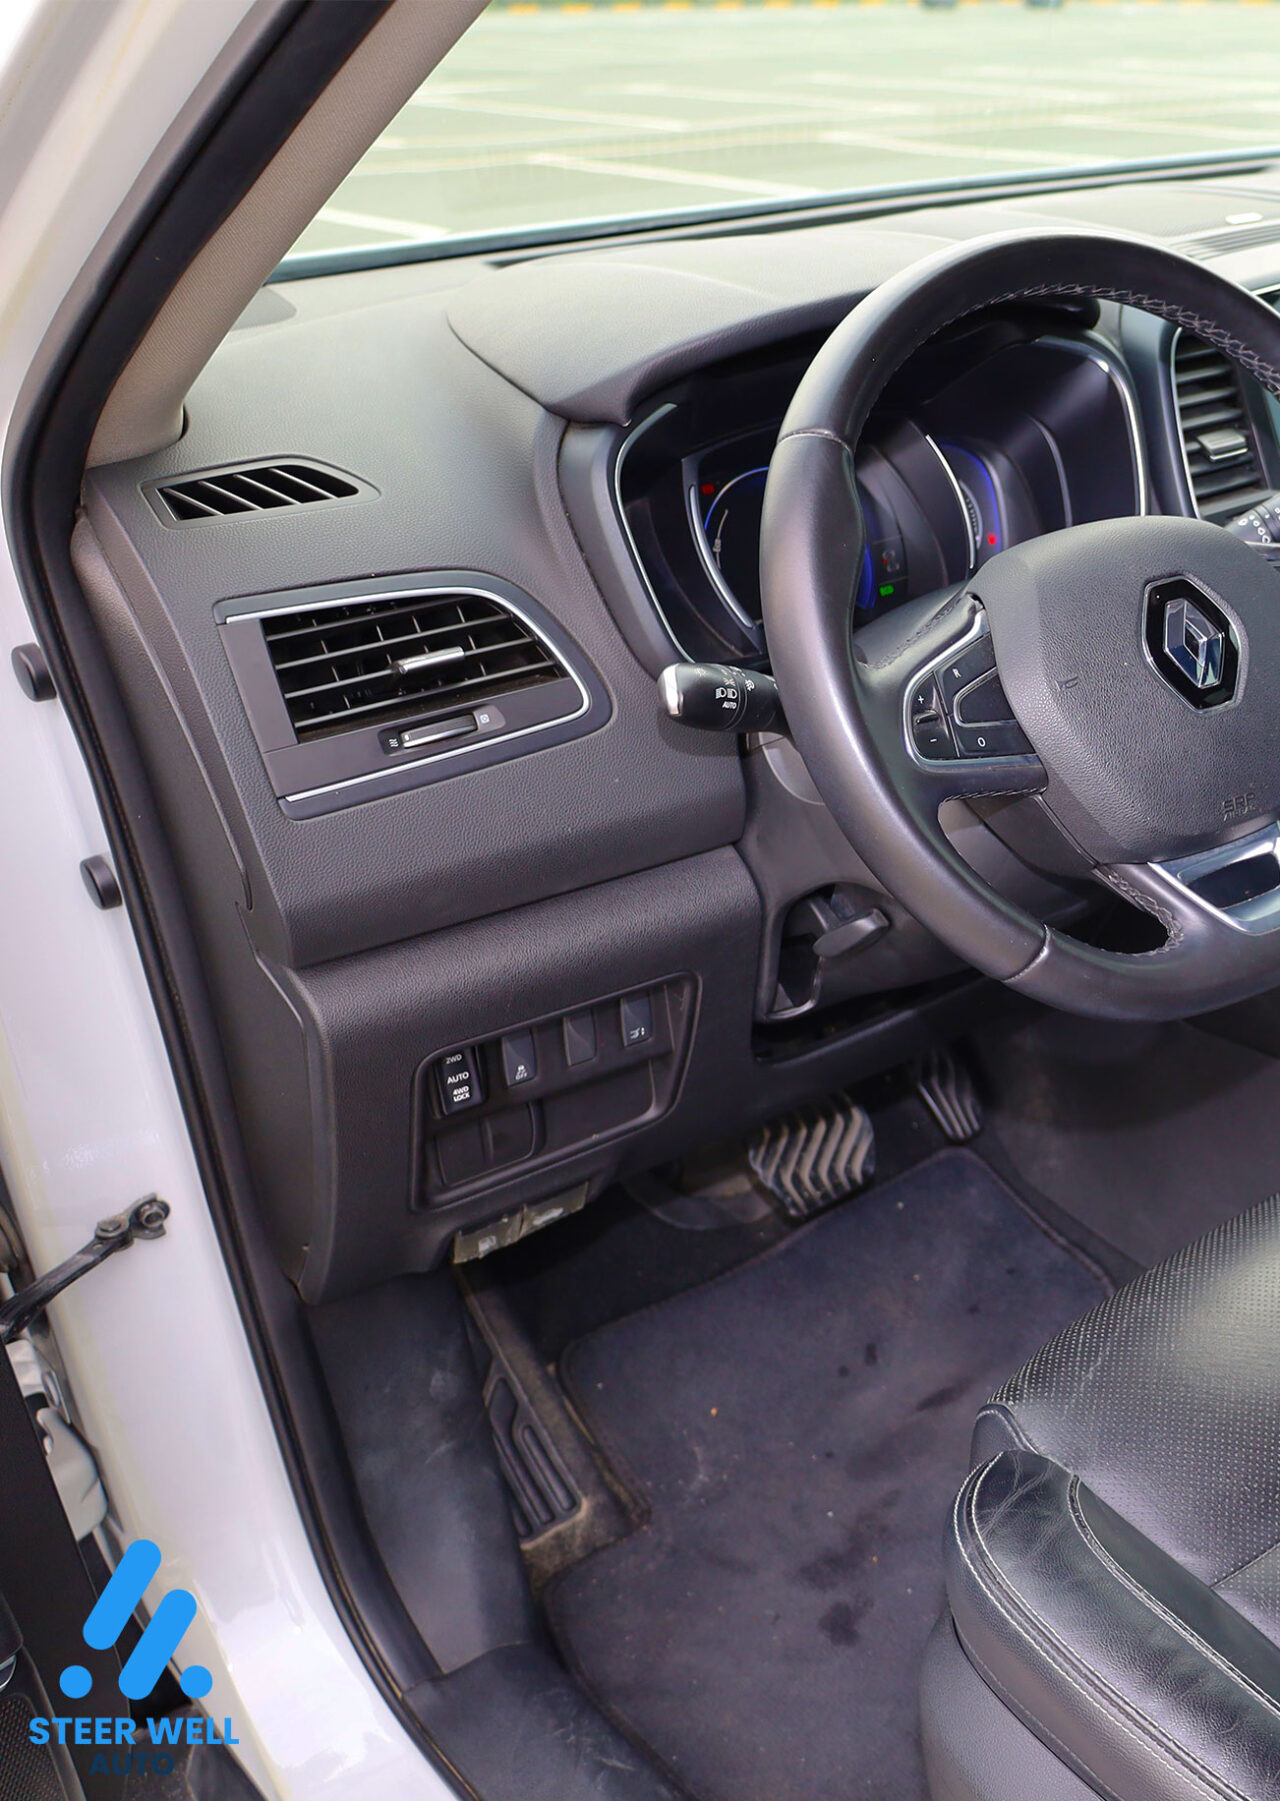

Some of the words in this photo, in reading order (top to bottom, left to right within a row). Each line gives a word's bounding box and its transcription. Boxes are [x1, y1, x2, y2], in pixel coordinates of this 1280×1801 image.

[722, 701, 737, 710] AUTO
[447, 1071, 470, 1085] AUTO
[453, 1085, 470, 1095] 4WD
[453, 1092, 471, 1102] LOCK
